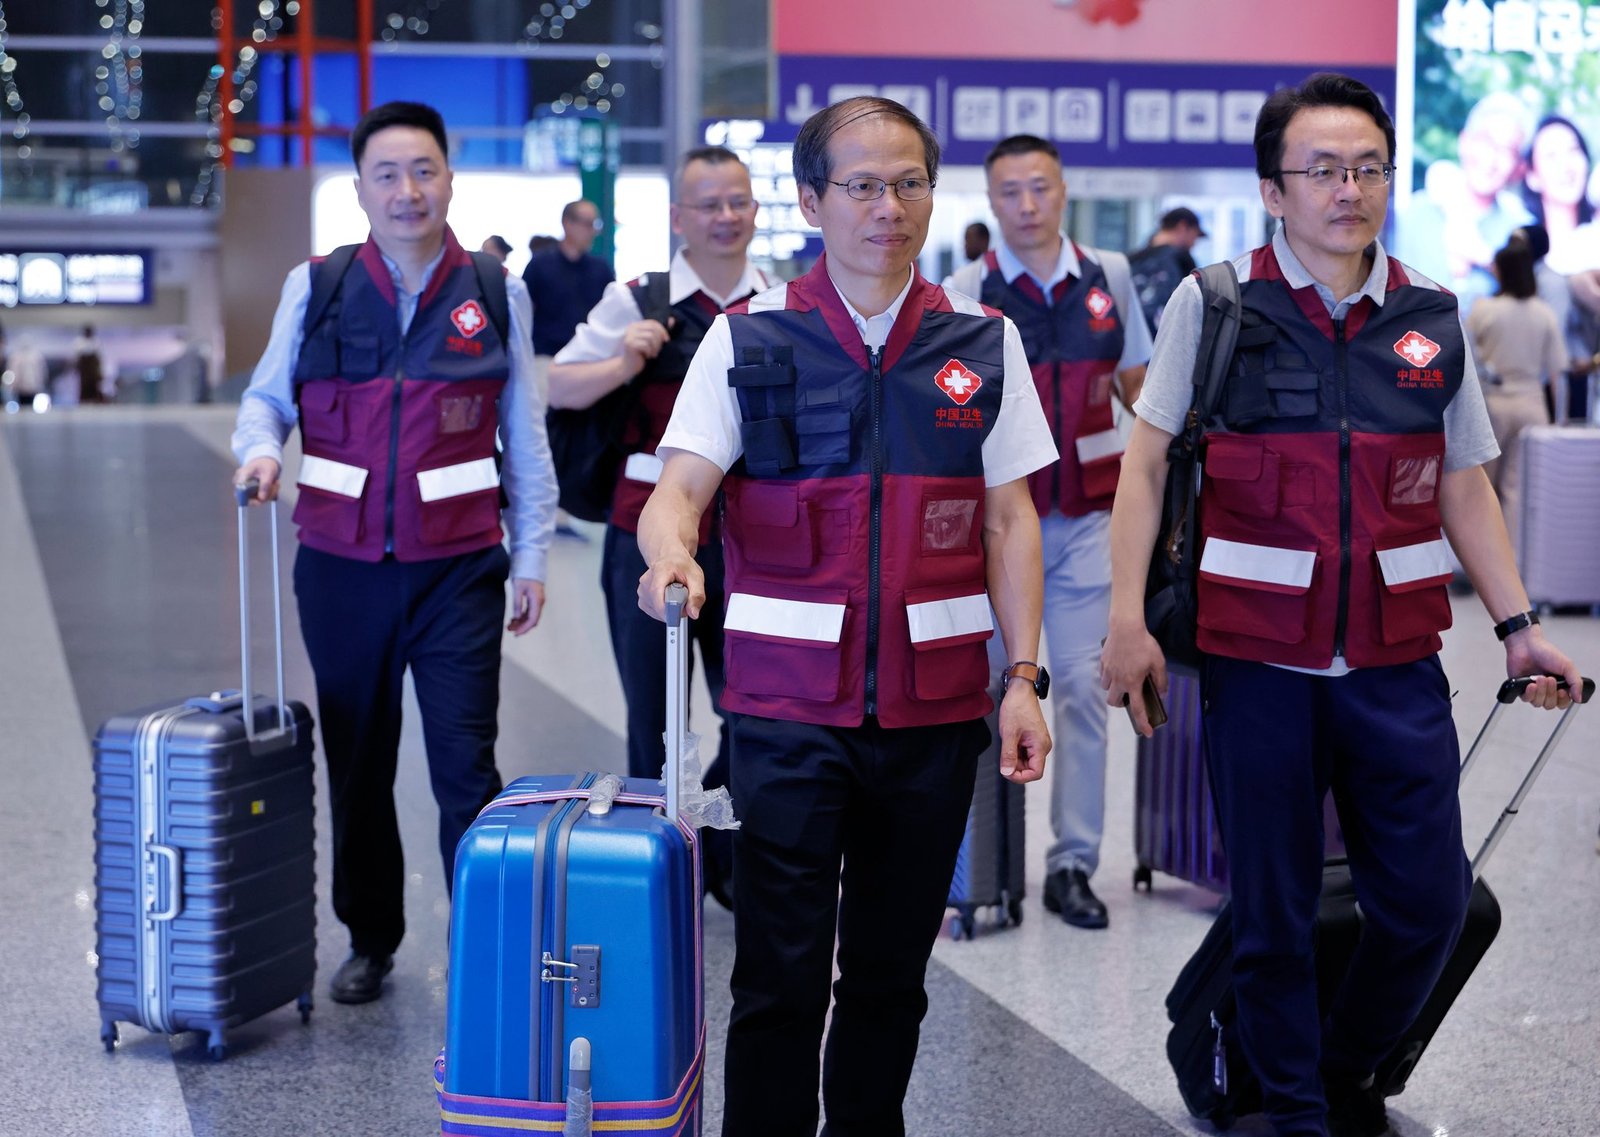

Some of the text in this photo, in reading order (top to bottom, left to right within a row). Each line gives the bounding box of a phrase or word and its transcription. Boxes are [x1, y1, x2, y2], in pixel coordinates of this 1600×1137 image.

[1397, 368, 1443, 382] 中国卫生
[935, 408, 982, 421] 中国卫生
[960, 421, 983, 429] HEALTH
